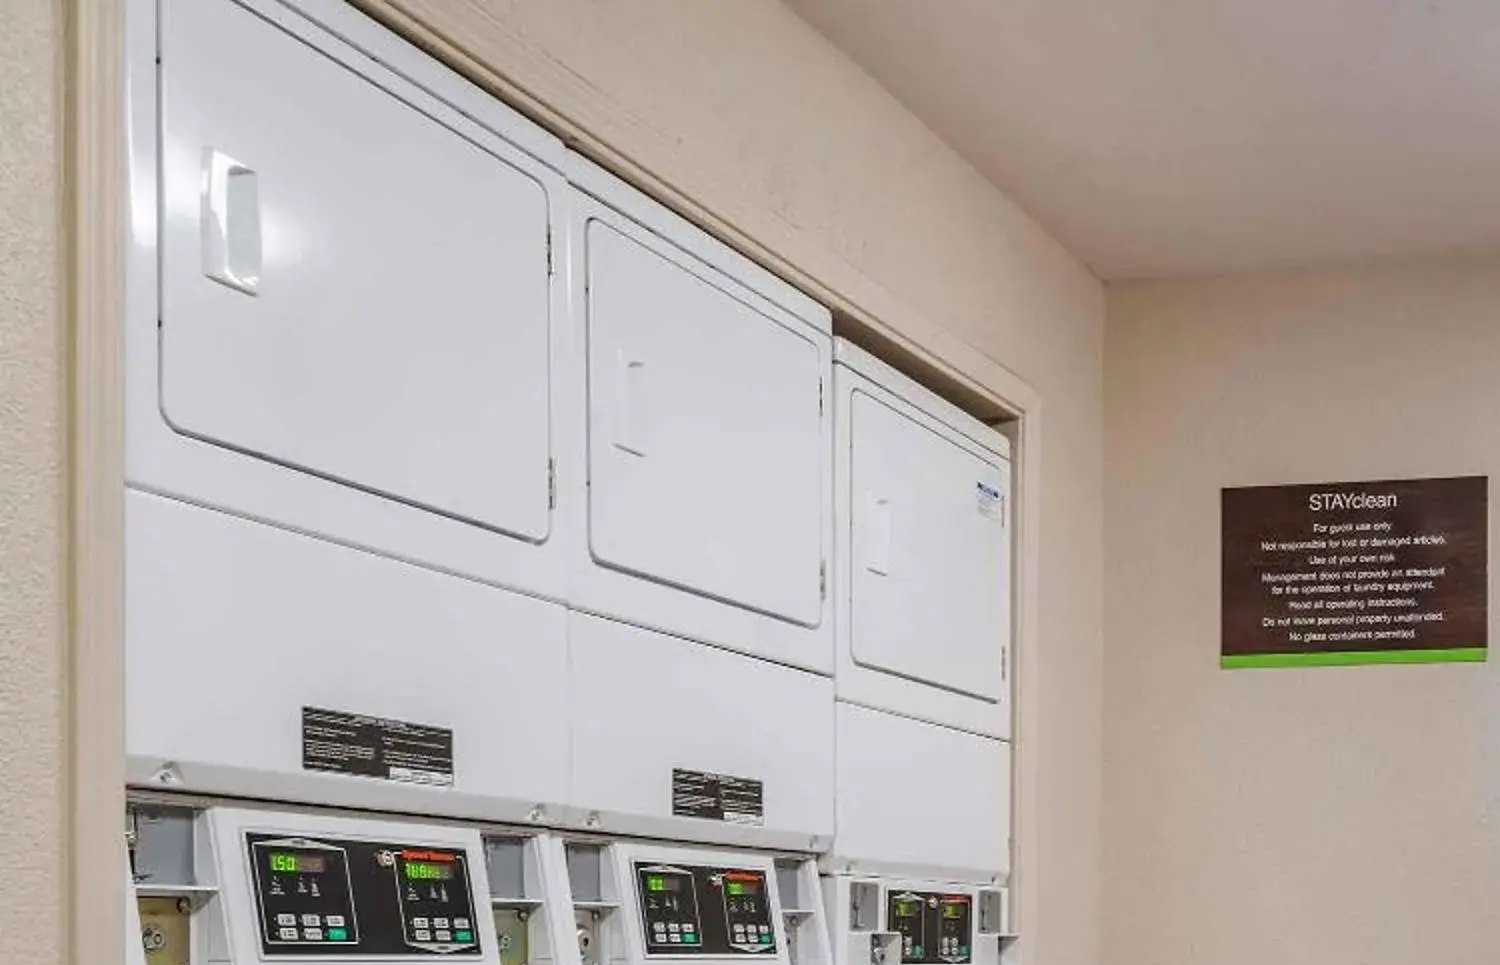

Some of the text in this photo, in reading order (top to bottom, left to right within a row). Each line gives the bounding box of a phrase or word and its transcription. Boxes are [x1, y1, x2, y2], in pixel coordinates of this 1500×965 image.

[1308, 491, 1398, 511] STAYclean
[1313, 523, 1328, 534] For
[1261, 541, 1277, 552] Not
[1328, 539, 1341, 549] for
[1370, 536, 1411, 550] damaged
[1309, 555, 1327, 565] Use
[1339, 554, 1359, 566] your
[1261, 571, 1318, 583] Management
[1272, 586, 1284, 596] for
[1353, 582, 1386, 594] laundry
[1325, 599, 1366, 611] operating
[1262, 617, 1276, 628] Do
[1277, 616, 1291, 627] not
[1317, 613, 1355, 627] personal
[1355, 613, 1392, 626] property
[1289, 631, 1303, 642] No
